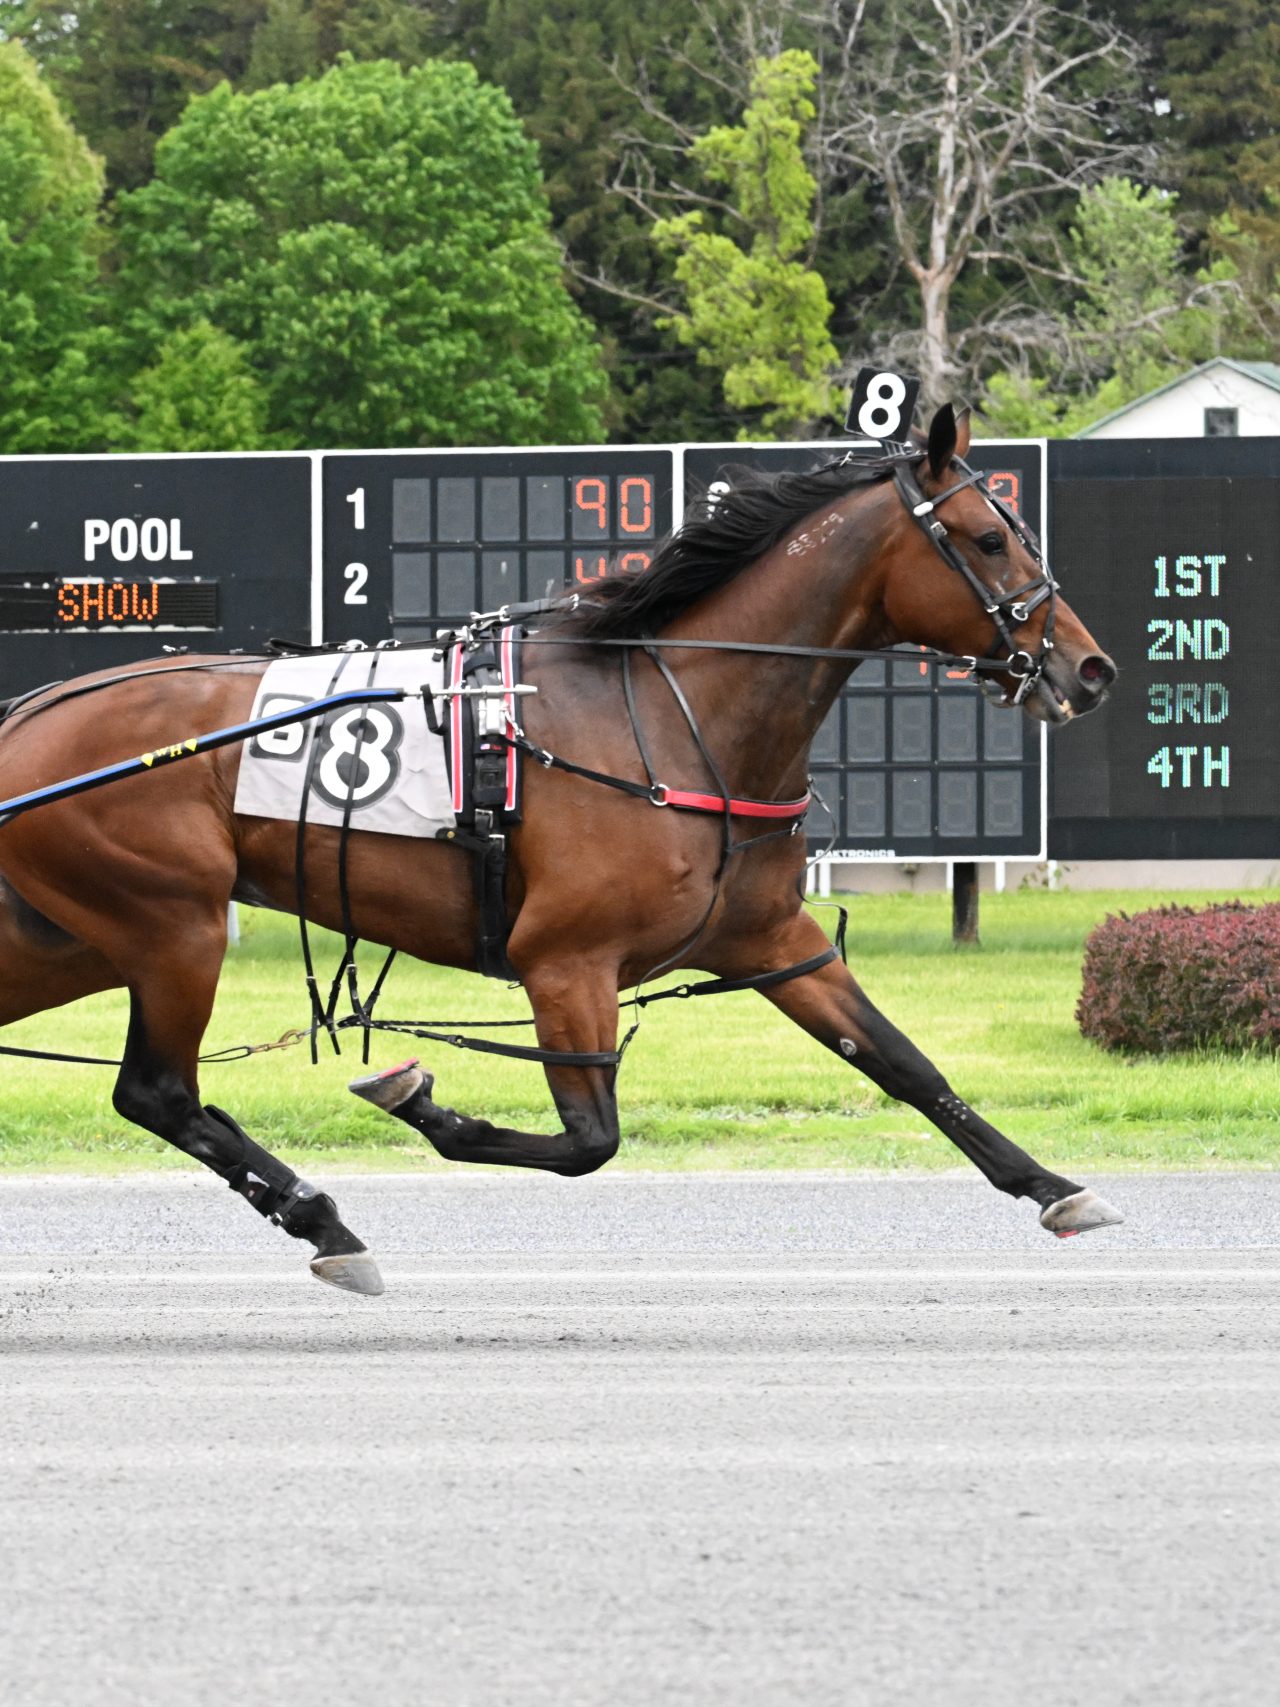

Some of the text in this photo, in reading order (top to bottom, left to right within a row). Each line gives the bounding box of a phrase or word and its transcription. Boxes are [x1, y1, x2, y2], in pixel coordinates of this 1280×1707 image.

[859, 372, 906, 438] 8
[347, 488, 364, 529] 1
[576, 478, 651, 532] 90
[85, 518, 193, 561] POOL
[344, 563, 368, 604] 2
[1155, 555, 1226, 597] 1ST
[59, 583, 158, 621] SHOW
[1147, 619, 1229, 661] 2ND
[1148, 683, 1229, 724] 3RD
[318, 705, 399, 806] 8
[1147, 746, 1229, 788] 4TH
